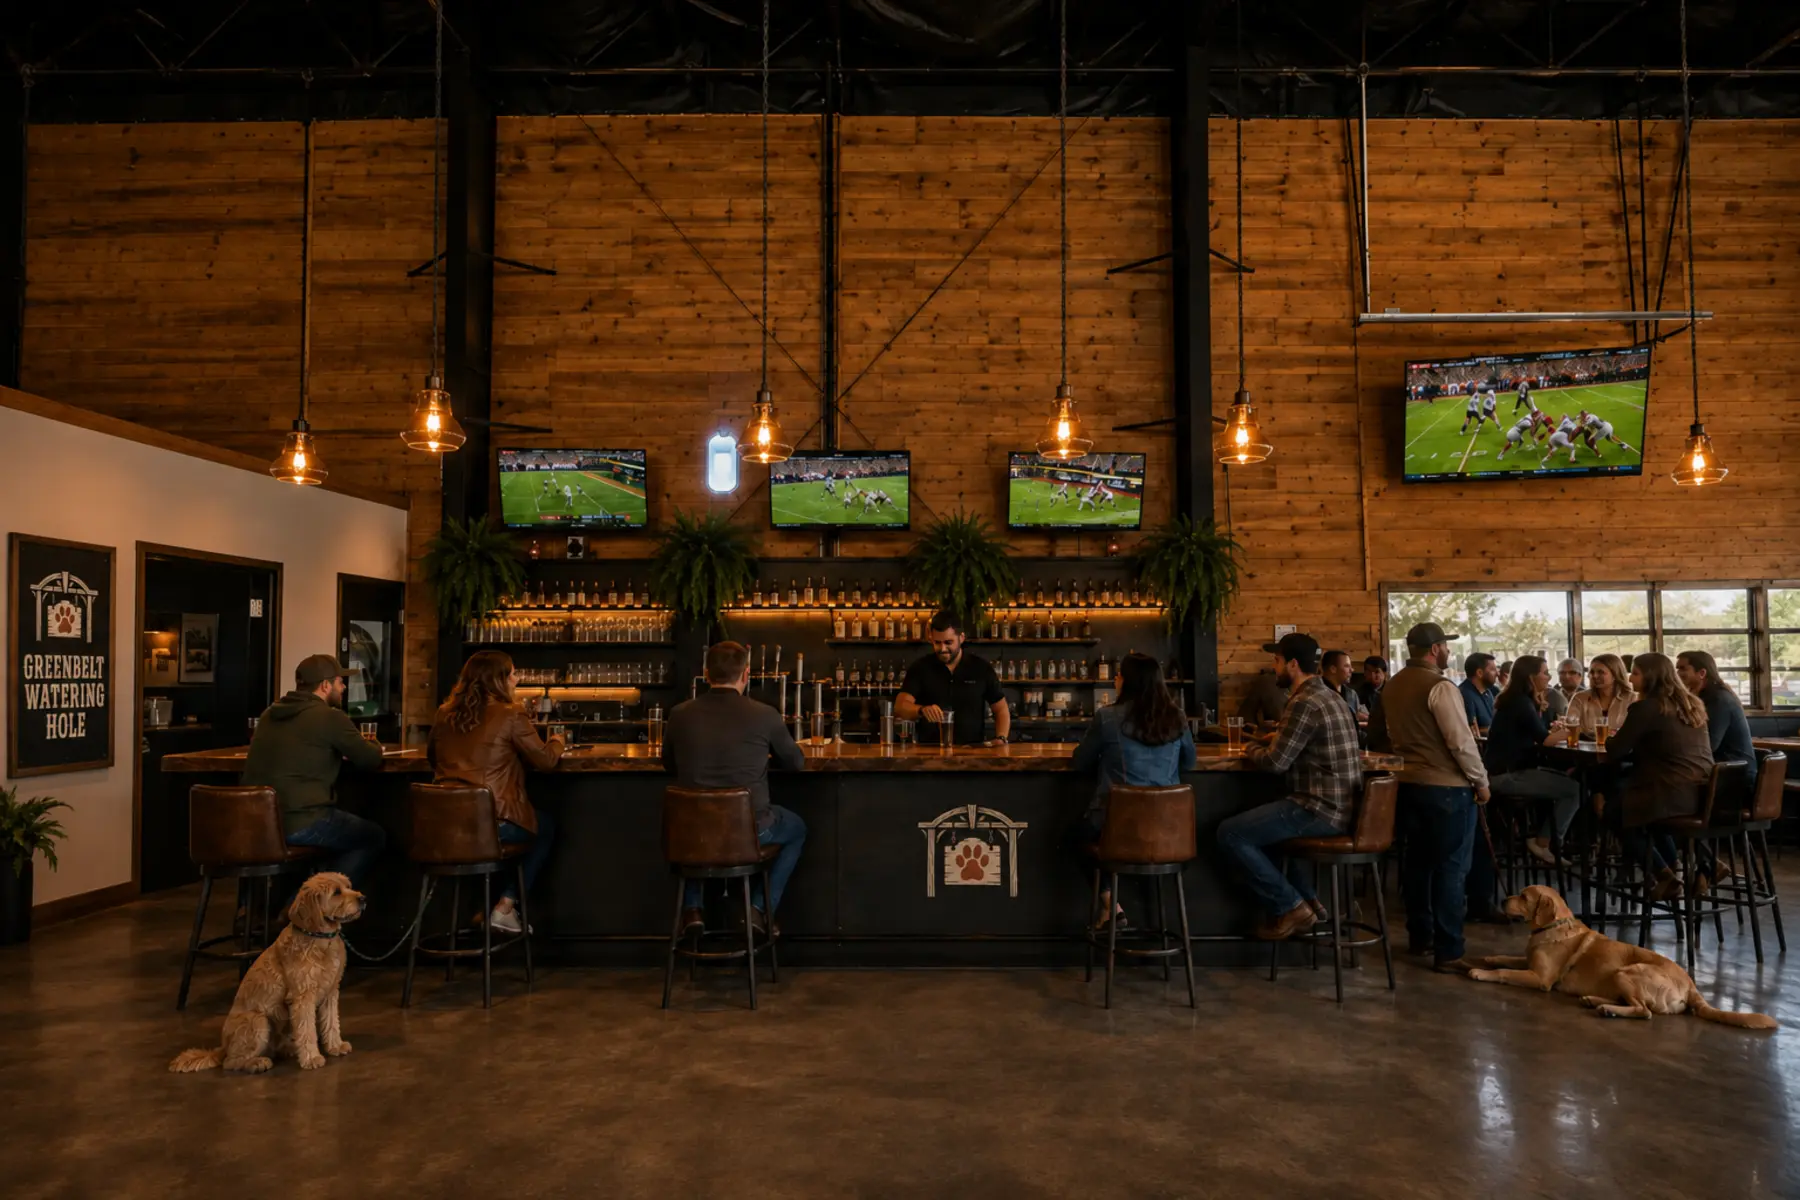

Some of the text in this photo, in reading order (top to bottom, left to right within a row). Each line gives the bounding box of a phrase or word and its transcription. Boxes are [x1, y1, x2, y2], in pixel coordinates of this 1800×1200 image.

[23, 654, 104, 680] GREENBELT
[24, 683, 105, 710] WATERING
[46, 712, 86, 739] HOLE
